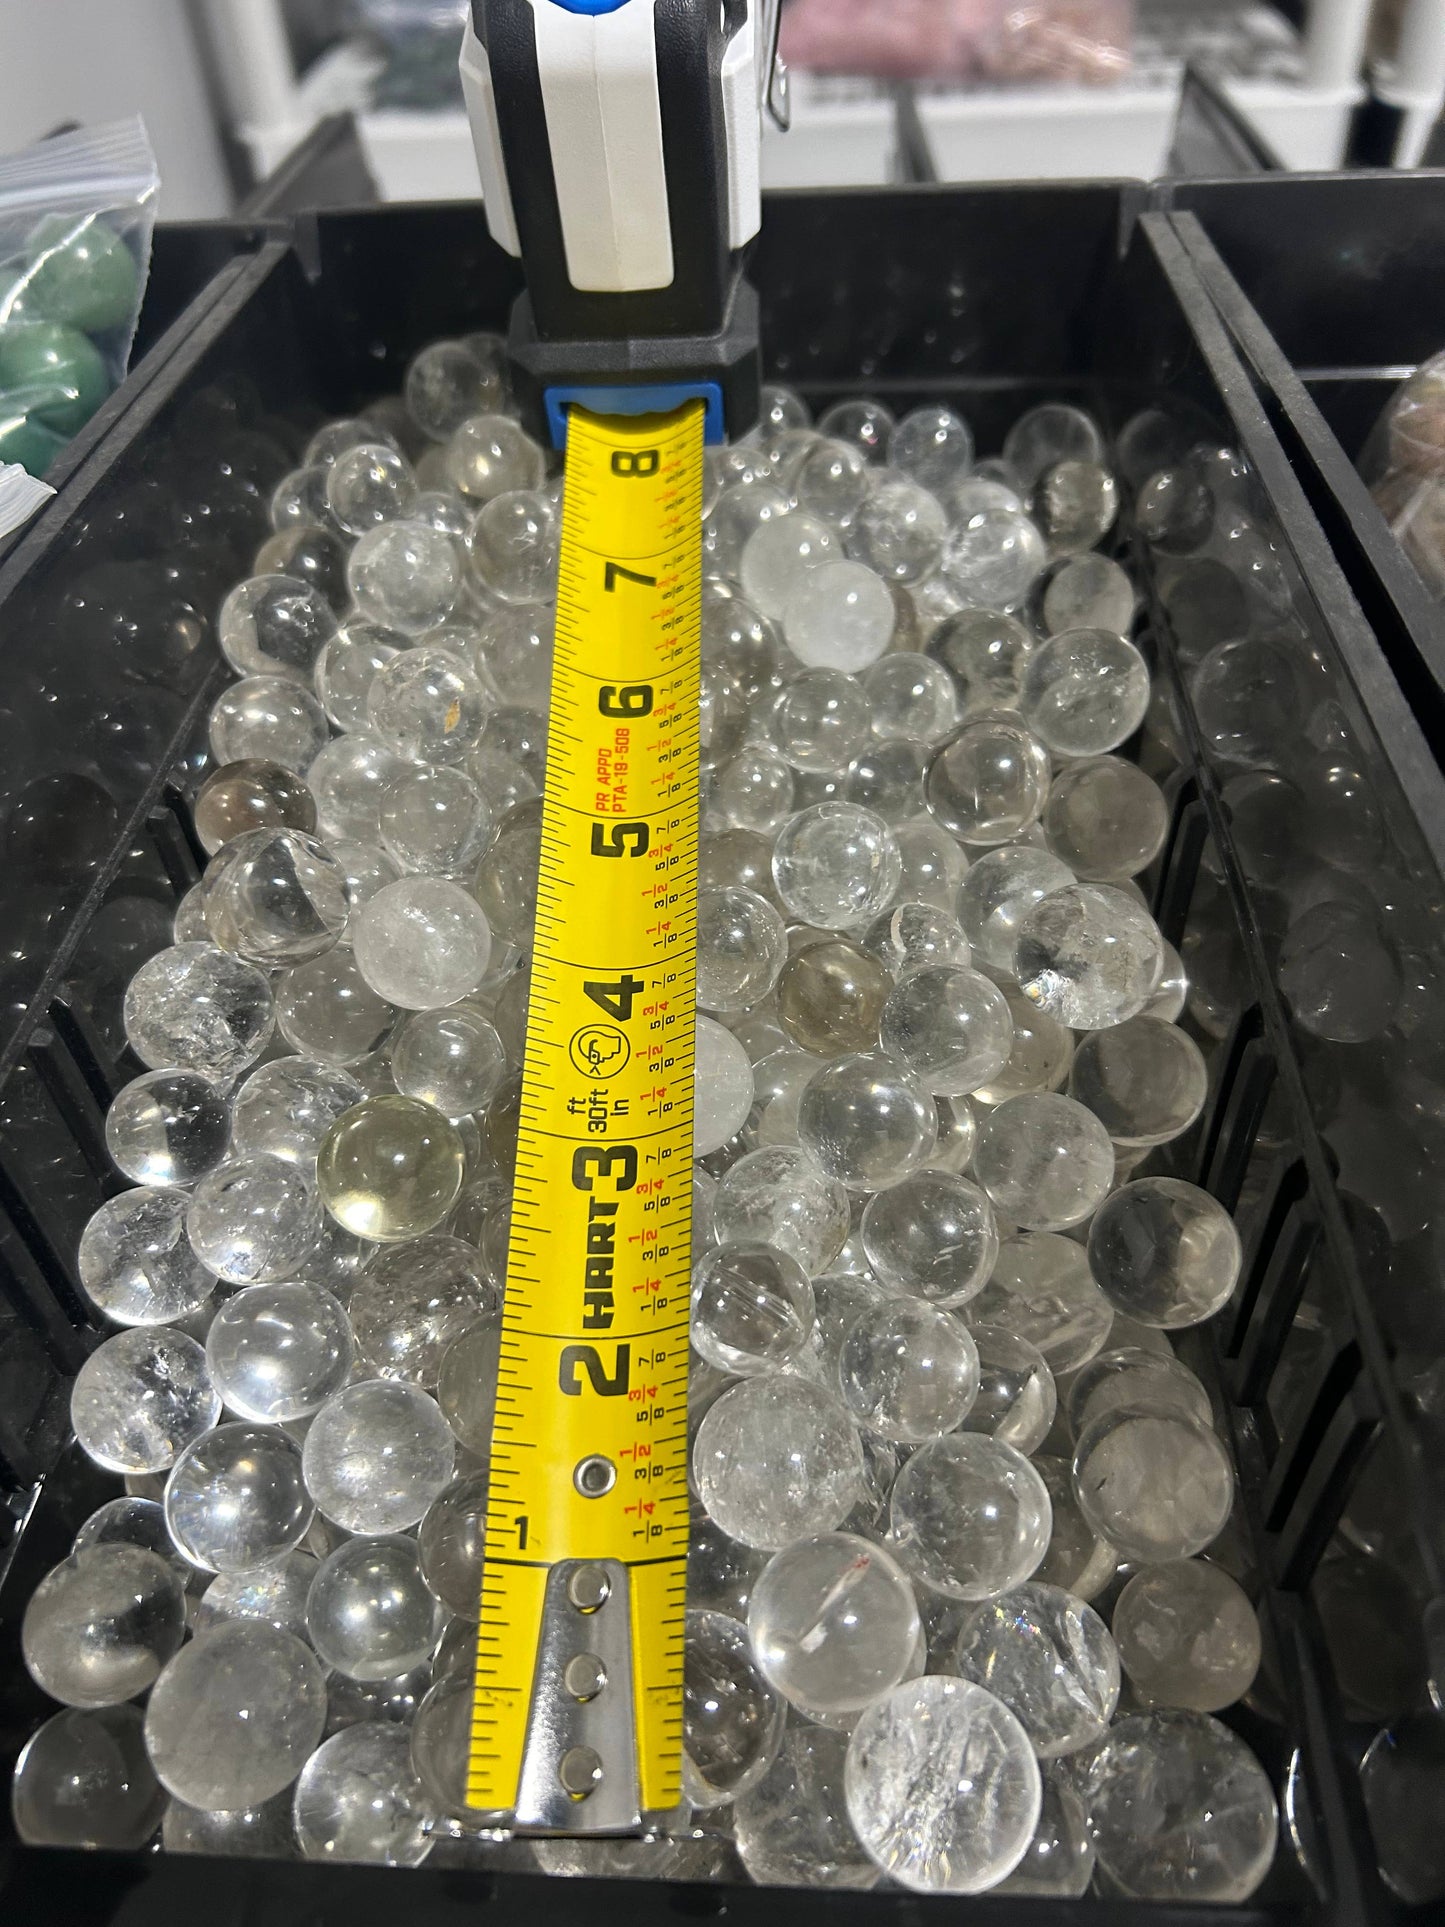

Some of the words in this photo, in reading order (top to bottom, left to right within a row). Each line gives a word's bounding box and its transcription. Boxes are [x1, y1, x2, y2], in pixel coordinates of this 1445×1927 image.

[612, 450, 660, 478] 8
[605, 561, 656, 592] 7
[660, 679, 683, 694] 7/8
[599, 685, 653, 718] 6
[659, 713, 682, 728] 5/8
[659, 748, 681, 763] 3/8
[612, 728, 630, 812] PTA-19-508
[658, 783, 681, 797] 1/8
[596, 792, 610, 812] PR
[657, 819, 679, 834] 7/8
[591, 822, 649, 857] 5
[649, 843, 673, 858] 3/4
[656, 856, 679, 871] 5/8
[642, 883, 667, 898] 1/2
[655, 894, 678, 909] 3/8
[646, 921, 671, 935] 1/4
[653, 933, 677, 948] 1/8
[652, 973, 676, 989] 7/8
[583, 975, 644, 1022] 4
[643, 1001, 669, 1016] 3/4
[650, 1014, 675, 1030] 5/8
[636, 1045, 663, 1060] 1/2
[649, 1057, 674, 1073] 3/8
[640, 1086, 667, 1102] 1/4
[567, 1097, 586, 1114] ft
[588, 1089, 608, 1133] 30ft
[611, 1099, 629, 1116] in
[648, 1101, 672, 1118] 1/8
[646, 1147, 672, 1165] 7/8
[572, 1145, 638, 1191] 3
[636, 1178, 664, 1195] 3/4
[644, 1194, 671, 1213] 5/8
[628, 1228, 658, 1246] 1/2
[583, 1196, 619, 1329] HART
[643, 1244, 669, 1263] 3/8
[633, 1277, 662, 1295] 1/4
[641, 1295, 668, 1316] 1/8
[638, 1349, 666, 1370] 7/8
[559, 1344, 630, 1396] 2
[629, 1384, 658, 1403] 3/4
[637, 1404, 665, 1426] 5/8
[620, 1442, 652, 1462] 1/2
[635, 1461, 663, 1484] 3/8
[624, 1498, 656, 1518] 1/4
[515, 1516, 528, 1549] 1
[633, 1520, 663, 1544] 1/8
